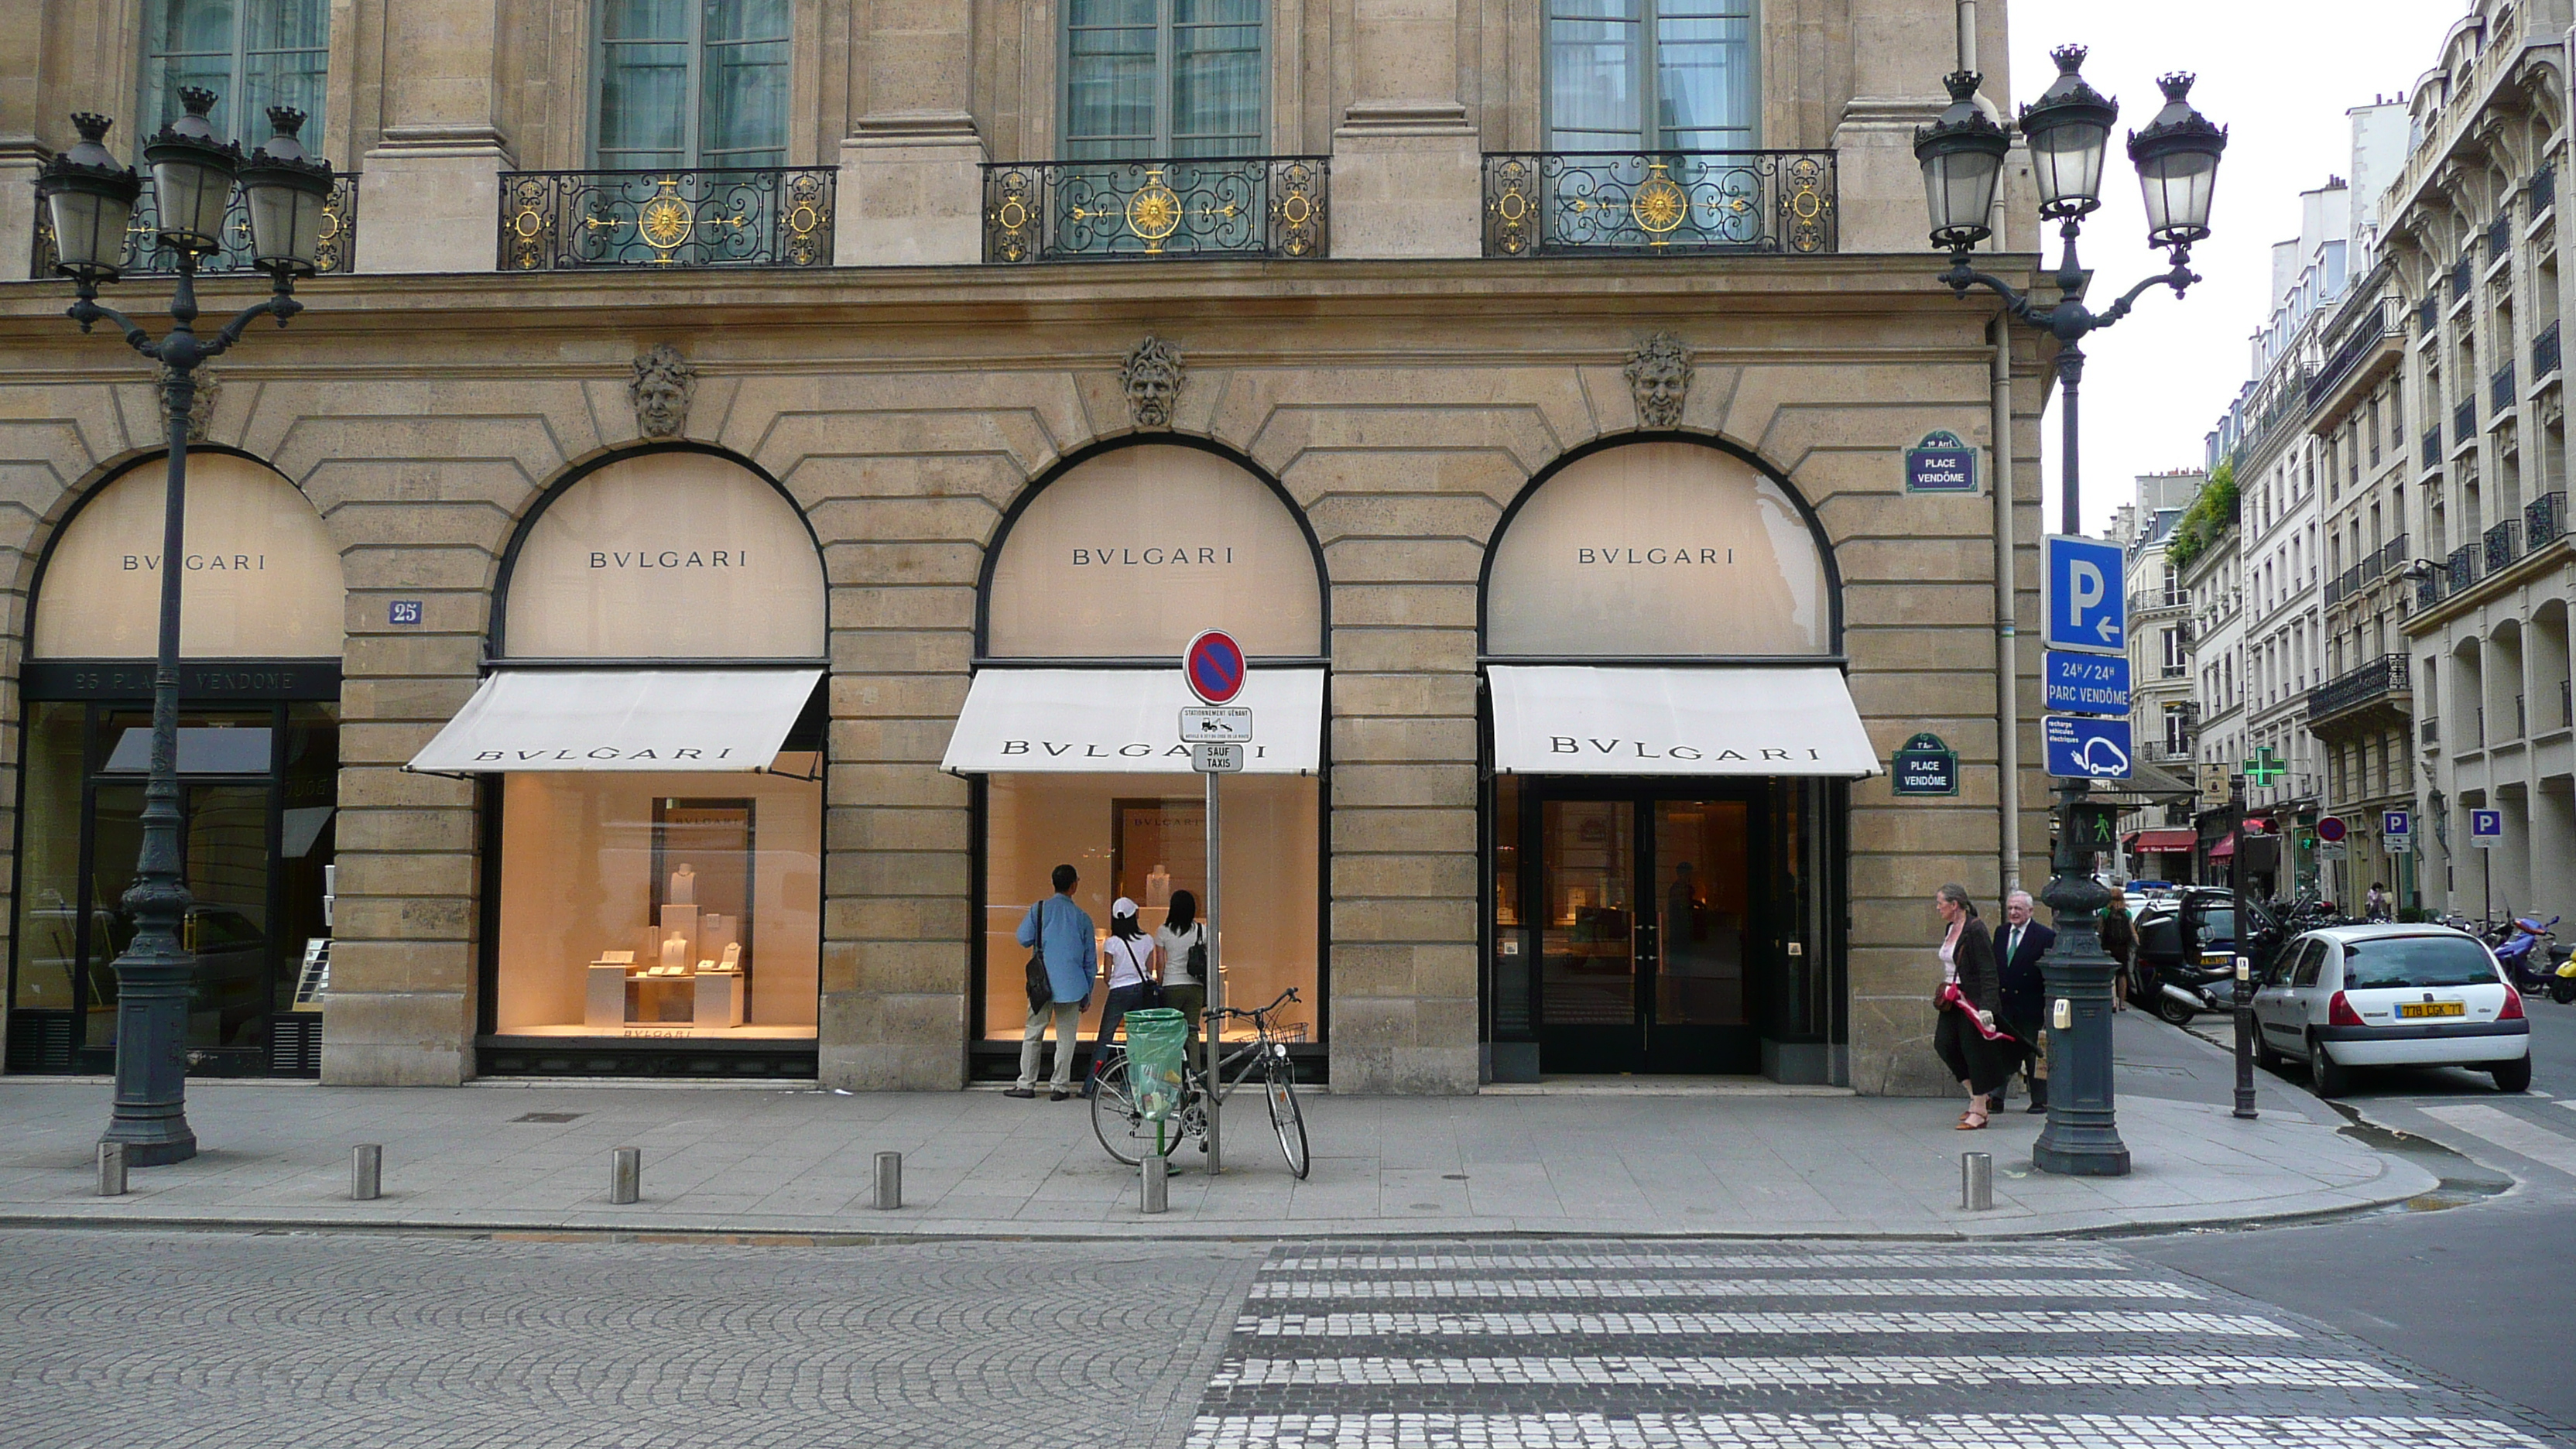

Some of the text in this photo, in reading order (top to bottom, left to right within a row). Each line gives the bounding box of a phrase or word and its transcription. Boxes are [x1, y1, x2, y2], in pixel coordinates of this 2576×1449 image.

[1925, 458, 1956, 468] PLACE
[1917, 471, 1965, 482] VENDÔME
[122, 554, 265, 570] BVGARI
[590, 550, 746, 568] BVLGARI
[1073, 547, 1233, 565] BVLGARI
[1578, 548, 1733, 564] BVLGARI
[2070, 559, 2105, 627] P
[393, 603, 417, 621] 25
[76, 673, 99, 690] 25
[196, 673, 294, 690] VENDOME
[2049, 685, 2129, 706] PARC VENDÔME
[474, 746, 733, 761] BVLGARI
[1000, 740, 1266, 759] BVLGAI
[1208, 747, 1230, 756] SAUF
[1550, 735, 1821, 761] BVLGARI
[1207, 759, 1231, 768] TAXIS
[1910, 761, 1940, 771] PLACE
[1904, 774, 1947, 786] VENDÔME
[2390, 815, 2402, 831] P
[2479, 814, 2494, 832] P
[2403, 1003, 2461, 1016] 778 CGK 77
[624, 1029, 691, 1038] BVLGARI
